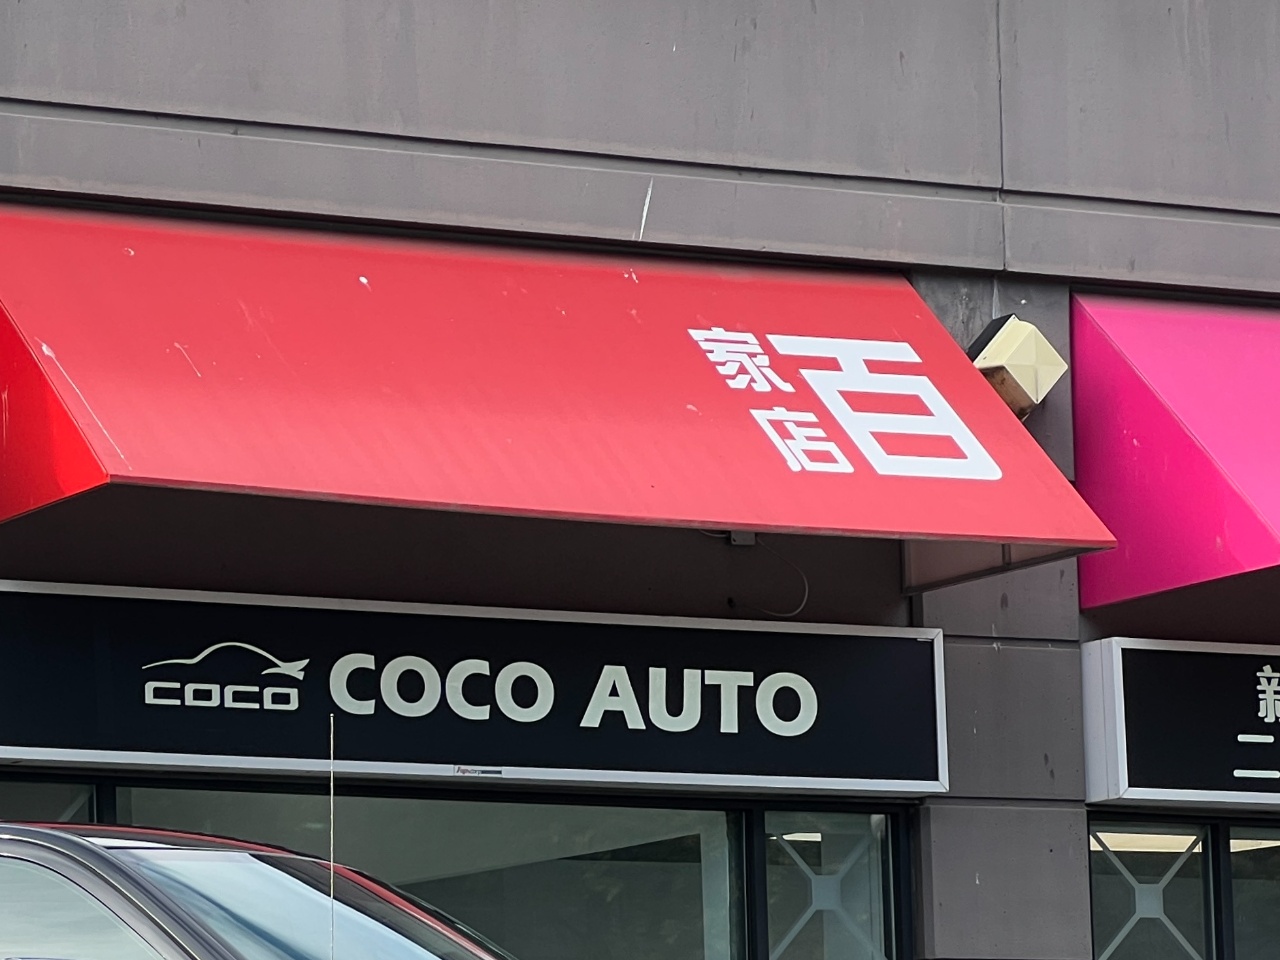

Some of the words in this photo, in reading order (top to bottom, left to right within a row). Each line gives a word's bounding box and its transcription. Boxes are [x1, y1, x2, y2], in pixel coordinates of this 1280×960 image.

[765, 334, 1003, 481] 百
[144, 680, 299, 711] COCO
[329, 653, 555, 723] COCO
[579, 665, 818, 737] AUTO
